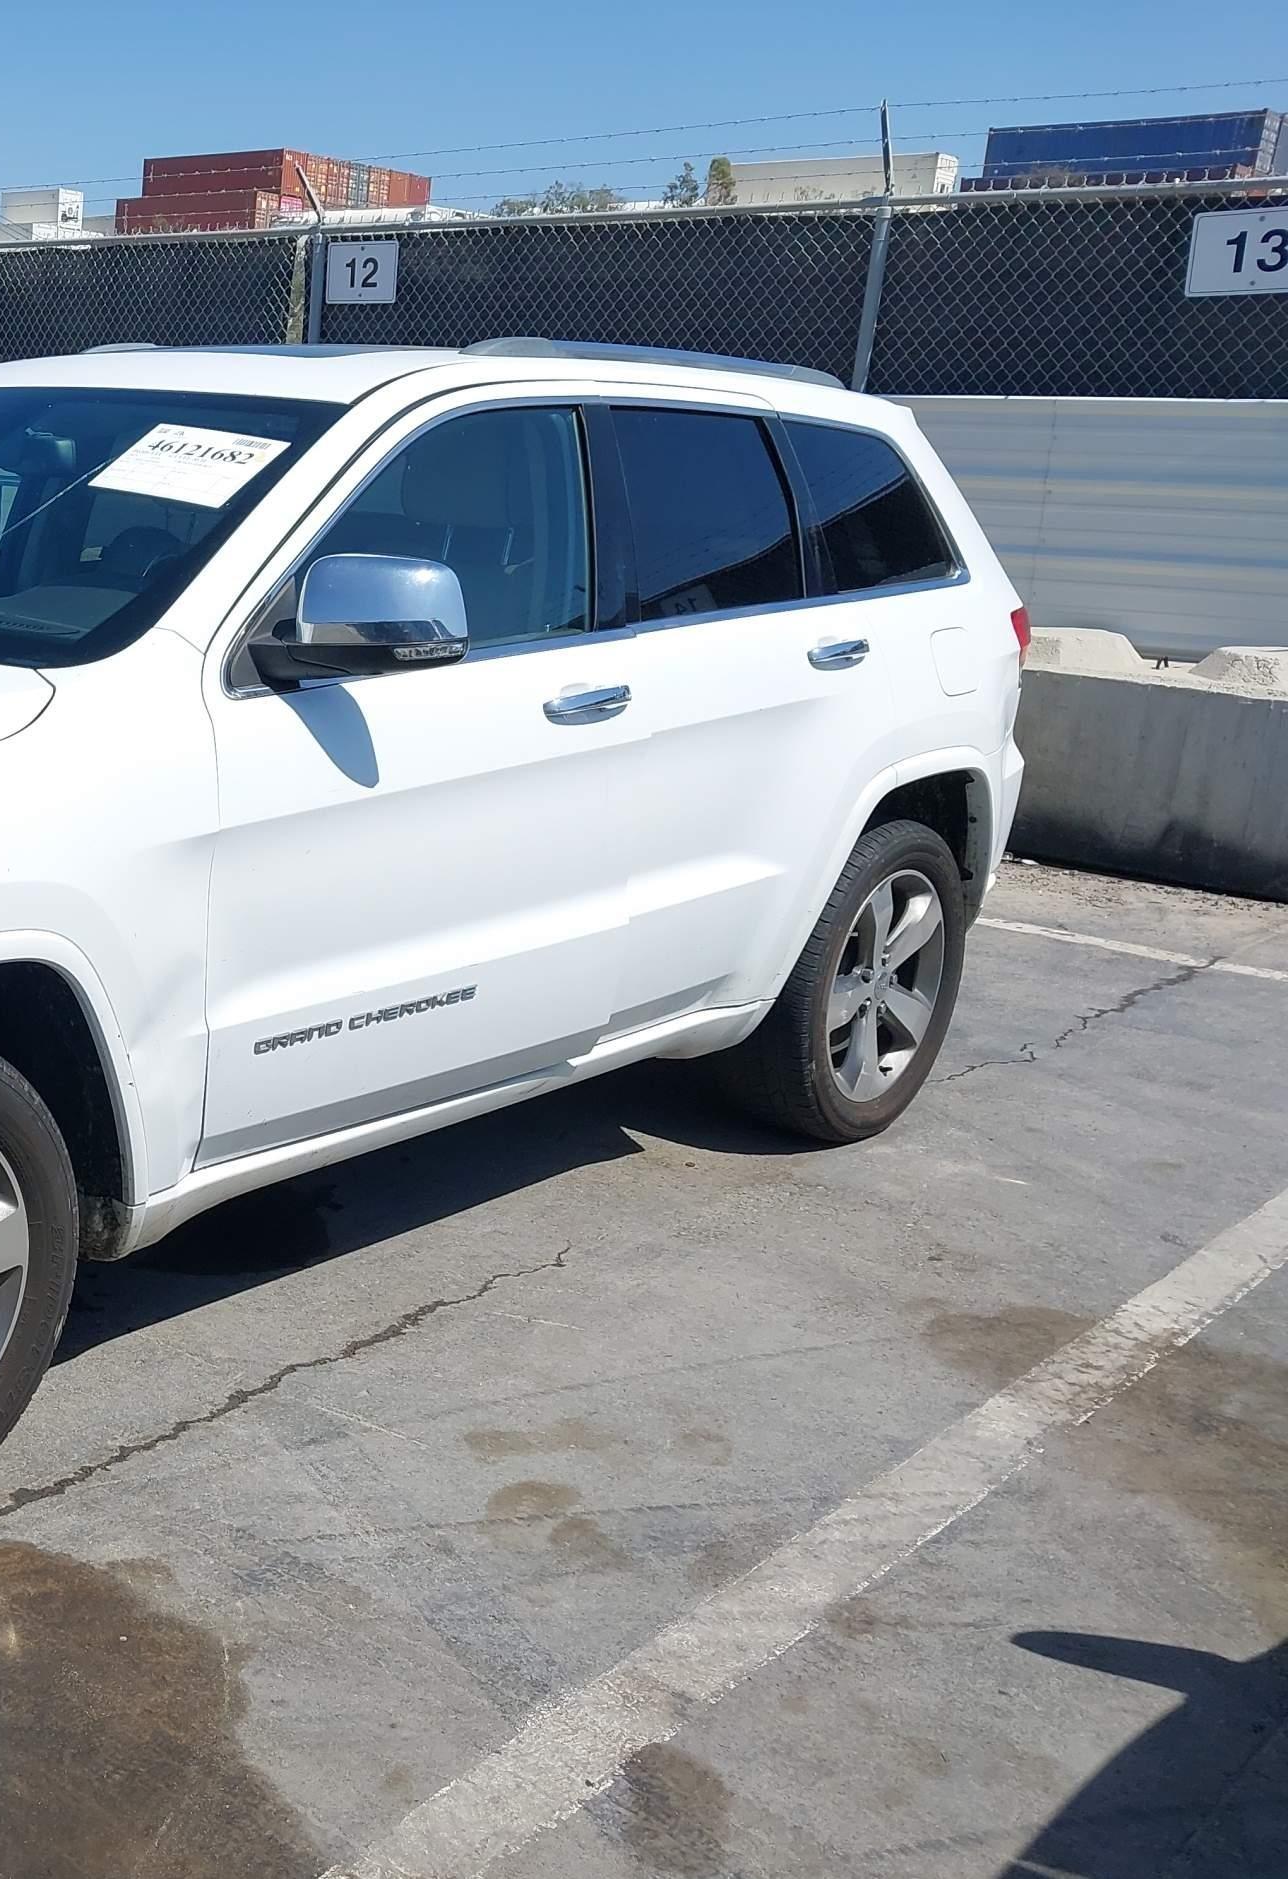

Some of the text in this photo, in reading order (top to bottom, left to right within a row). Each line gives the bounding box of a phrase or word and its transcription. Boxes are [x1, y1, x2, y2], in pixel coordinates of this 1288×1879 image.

[1226, 229, 1288, 273] 13
[345, 257, 379, 289] 12
[148, 439, 255, 465] 46121682
[253, 984, 479, 1056] GRAND CHEROKEE
